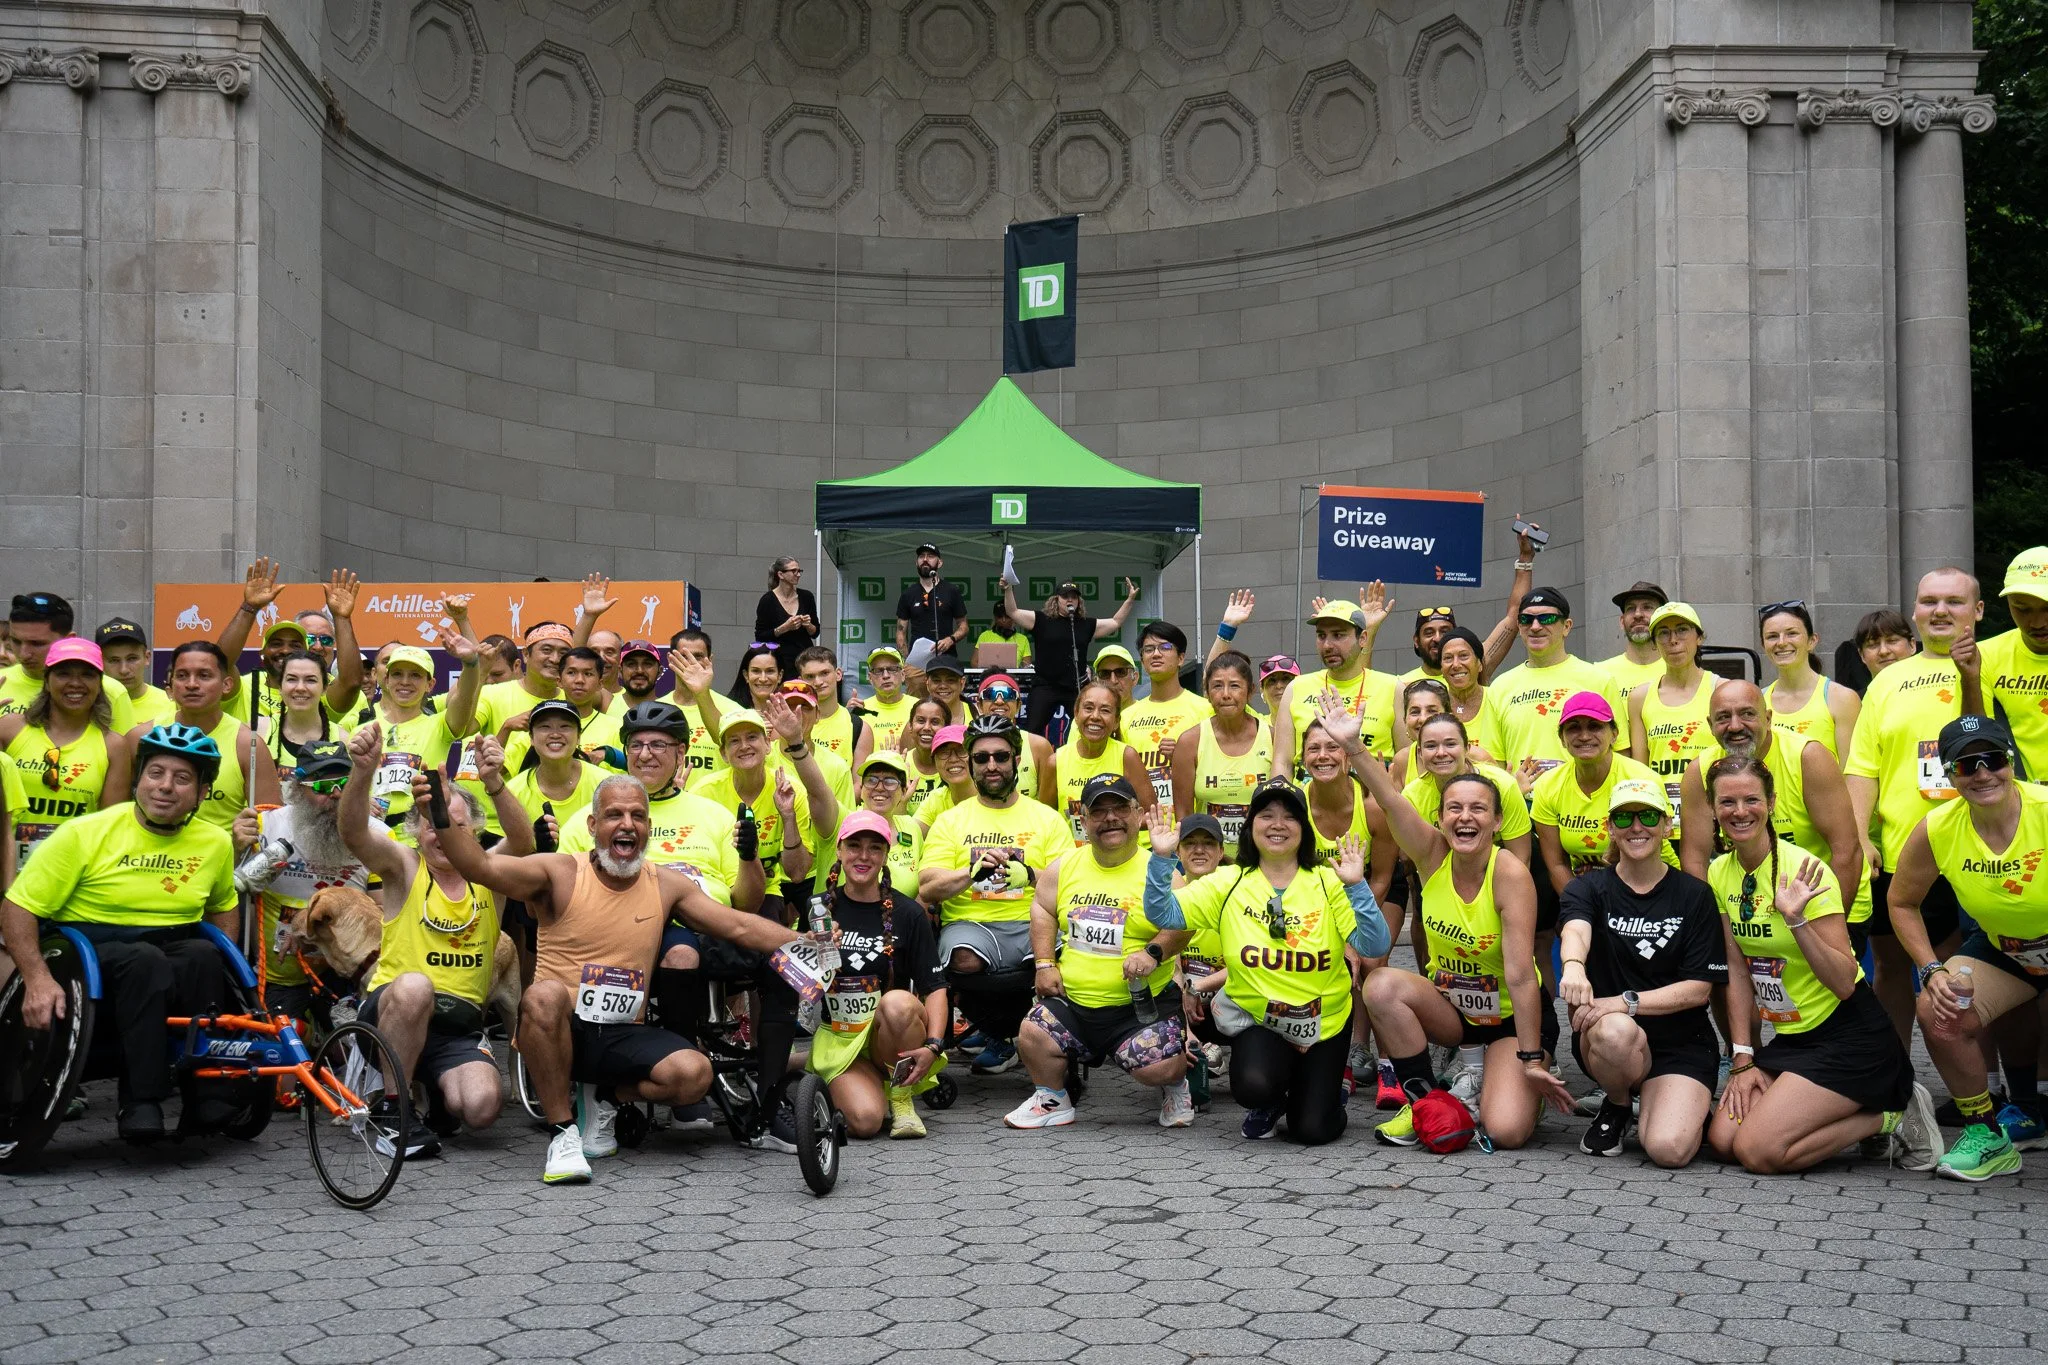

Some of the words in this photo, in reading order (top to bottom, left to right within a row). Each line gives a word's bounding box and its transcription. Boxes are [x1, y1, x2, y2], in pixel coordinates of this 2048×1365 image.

[1022, 274, 1060, 309] TD
[996, 499, 1024, 519] TD
[1334, 506, 1387, 526] Prize
[1333, 529, 1436, 556] Giveaway
[860, 581, 883, 597] TD
[1032, 581, 1054, 597] TD
[365, 593, 444, 614] Achilles
[842, 626, 863, 640] TD
[1510, 689, 1551, 706] Achilles
[873, 721, 897, 730] Achilles
[1129, 715, 1166, 730] Achilles
[1648, 722, 1684, 737] Achilles
[684, 755, 714, 770] IDE
[1139, 750, 1172, 768] UID
[1651, 758, 1693, 776] GUID
[376, 772, 382, 785] J
[389, 768, 412, 785] 2123
[1923, 762, 1933, 778] L
[1068, 777, 1088, 787] Achi
[1153, 783, 1172, 799] 921
[27, 796, 89, 818] UIDE
[1074, 818, 1083, 832] E
[1557, 813, 1599, 829] Achilles
[649, 827, 677, 838] illes
[963, 832, 1015, 846] Achilles
[19, 843, 30, 859] F
[1317, 848, 1341, 858] hille
[117, 854, 184, 870] Achilles
[1962, 857, 2021, 874] Achilles
[283, 871, 314, 880] REEDOM
[1983, 870, 2023, 879] INTERNATIONAL
[1069, 893, 1120, 907] Achilles
[1728, 893, 1754, 906] Achs
[1243, 905, 1301, 925] Aches
[1072, 922, 1079, 939] L
[1086, 925, 1116, 946] 8421
[1425, 914, 1477, 946] Achilles
[1731, 921, 1773, 938] GUIDE
[839, 932, 874, 946] illes
[426, 951, 484, 968] GUIDE
[1185, 953, 1218, 964] hilles
[1240, 944, 1332, 973] GUIDE
[1437, 955, 1482, 976] GUIDE
[1756, 981, 1784, 1002] 2269
[582, 989, 596, 1007] G
[601, 991, 637, 1014] 5787
[829, 997, 840, 1011] D
[844, 996, 877, 1015] 3952
[1457, 993, 1494, 1011] 1904
[1266, 1015, 1279, 1028] H
[1283, 1021, 1317, 1039] 1933
[208, 1040, 230, 1056] TOP
[225, 1041, 252, 1057] END
